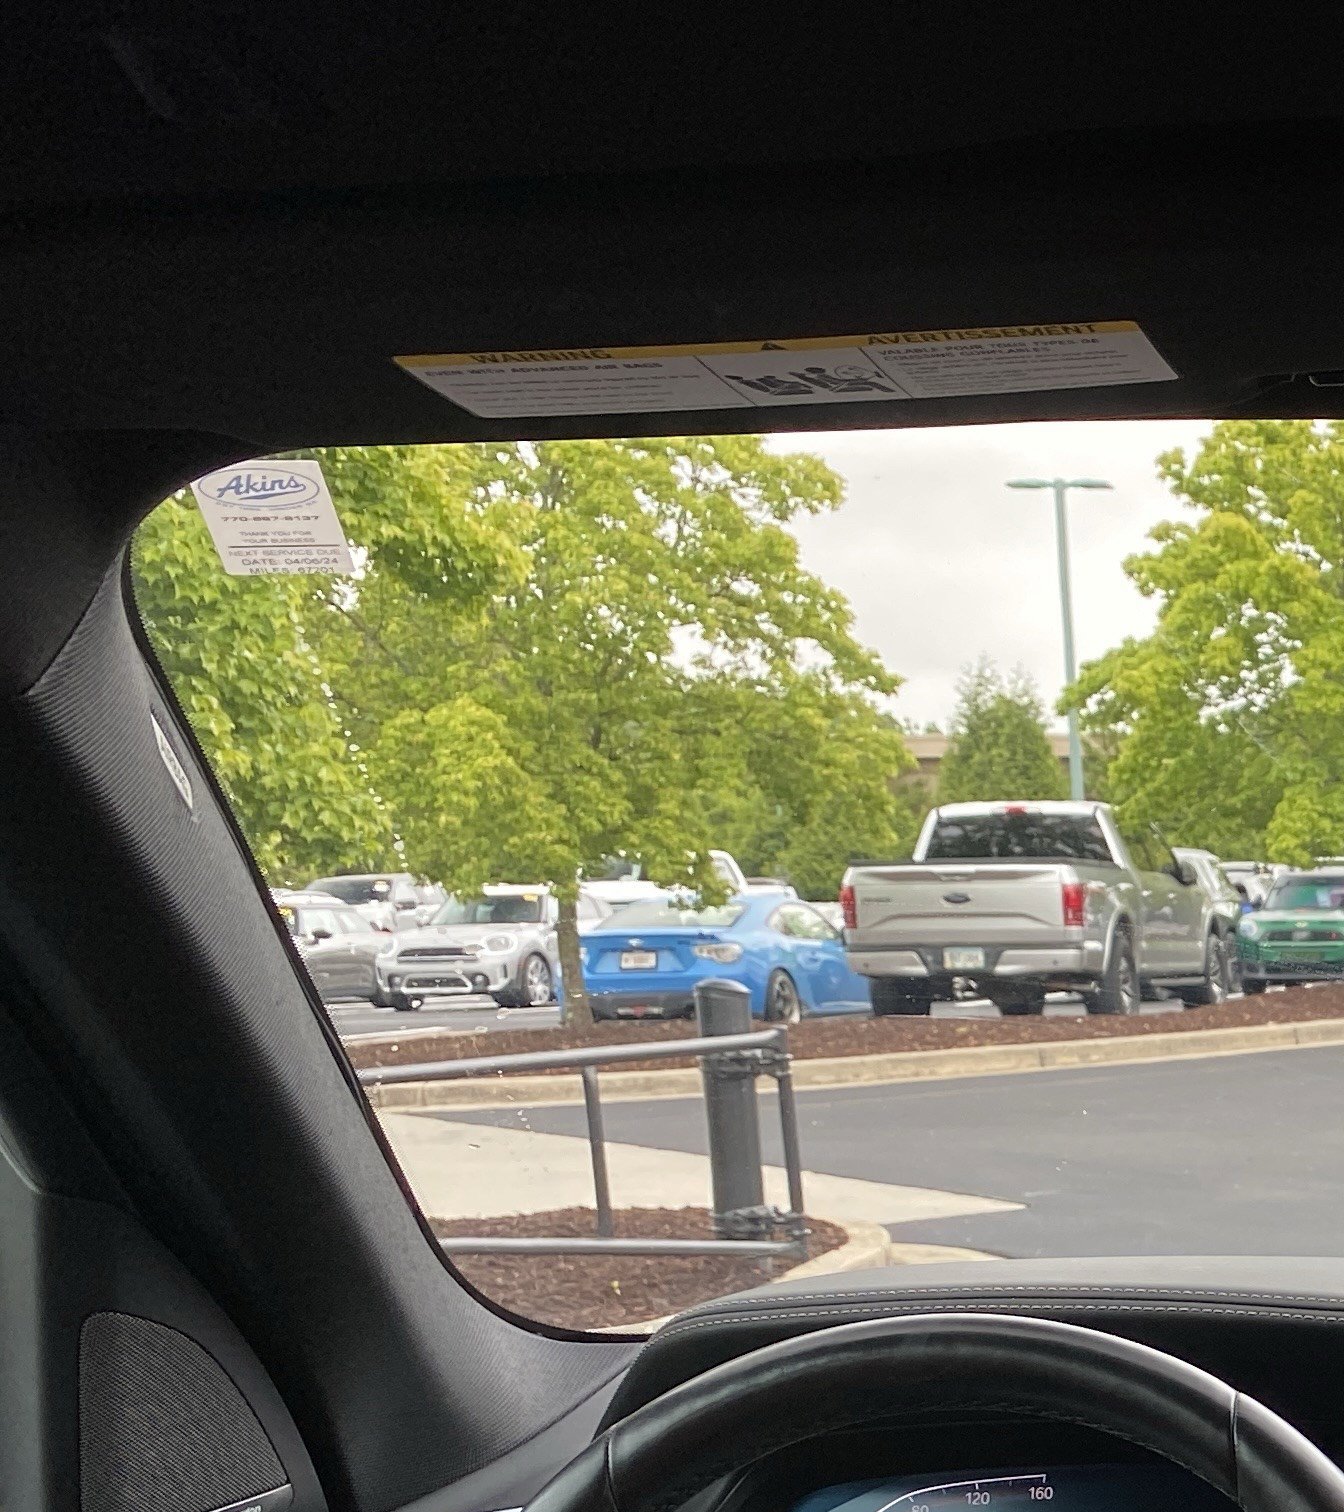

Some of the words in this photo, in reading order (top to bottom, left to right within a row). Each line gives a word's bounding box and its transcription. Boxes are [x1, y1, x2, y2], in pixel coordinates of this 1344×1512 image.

[867, 324, 1098, 346] AVERTISSEMENT
[470, 349, 612, 364] WARNING
[217, 474, 306, 500] Akins
[965, 1491, 991, 1506] 120
[1028, 1486, 1054, 1501] 160
